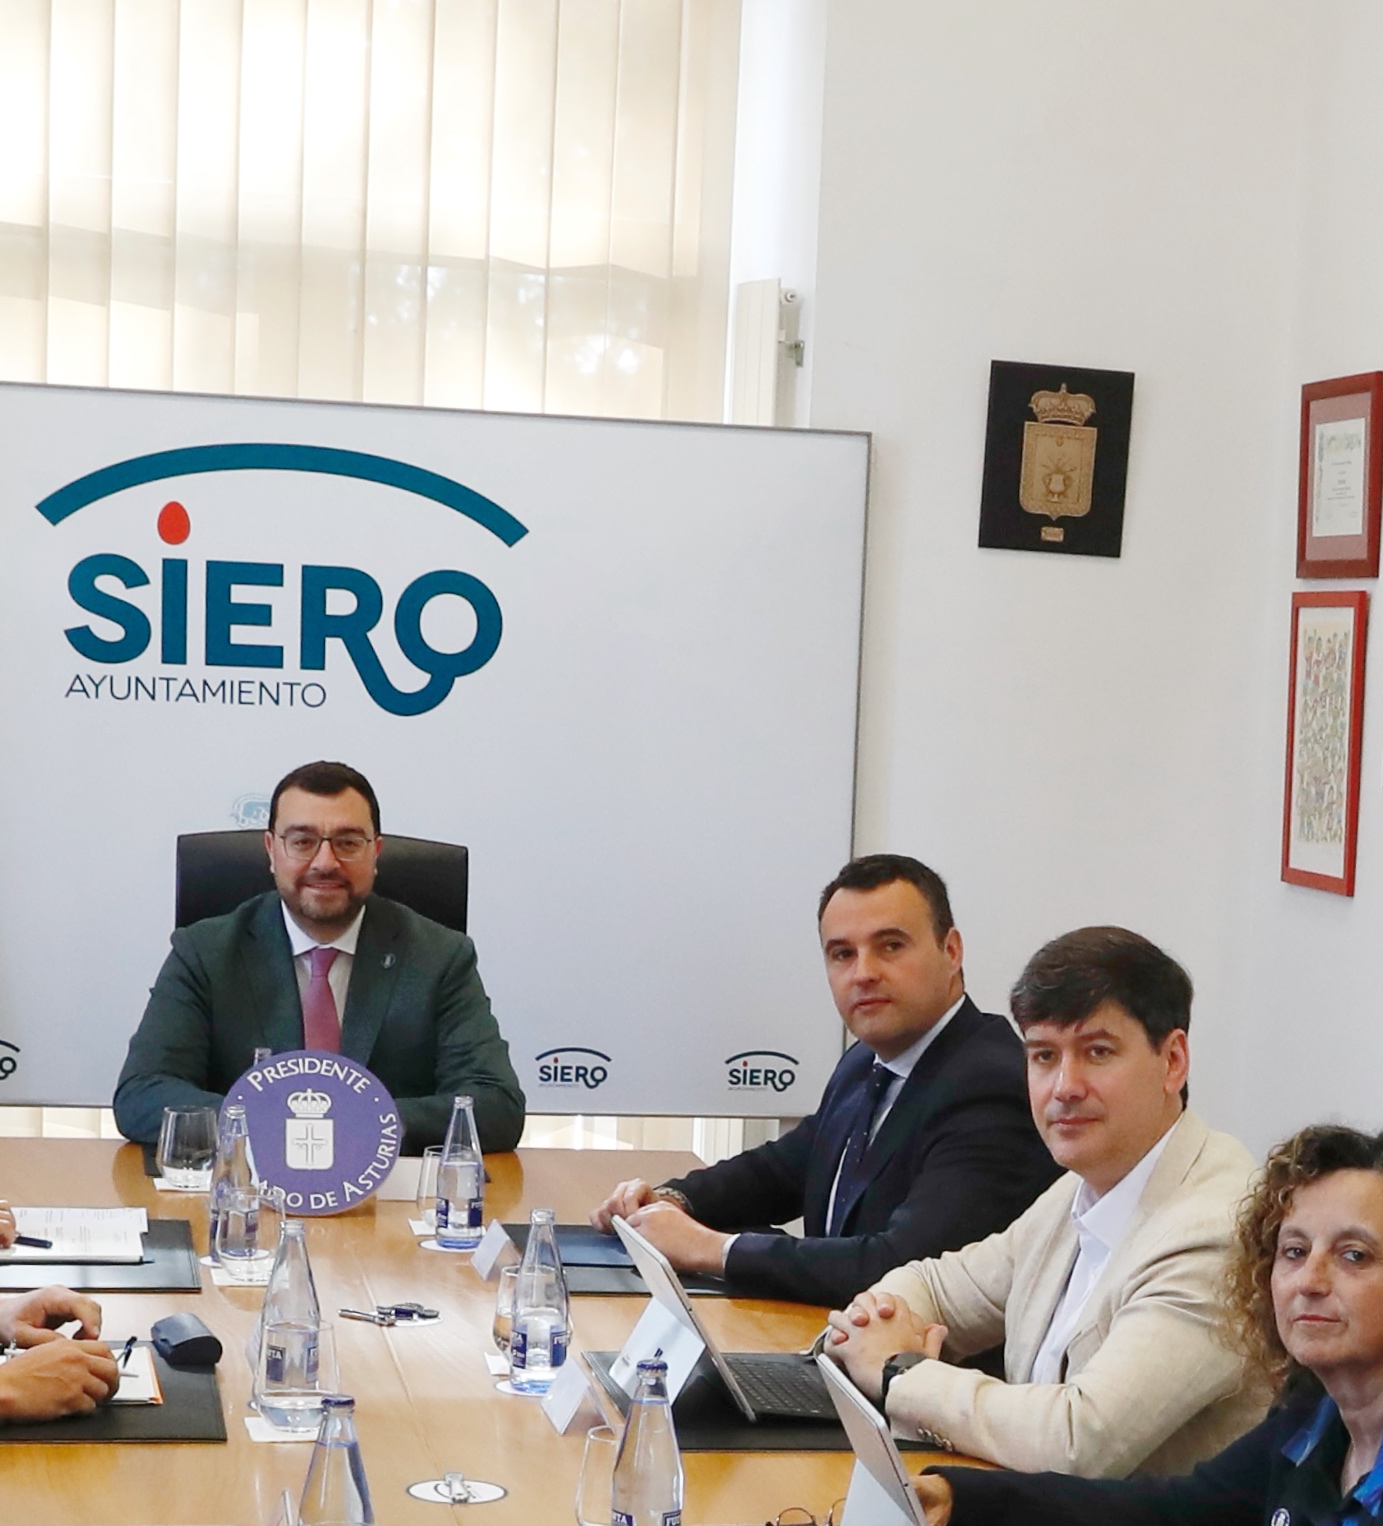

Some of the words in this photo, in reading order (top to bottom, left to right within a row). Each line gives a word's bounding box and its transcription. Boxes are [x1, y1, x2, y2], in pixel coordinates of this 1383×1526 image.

[65, 674, 327, 708] AYUNTAMIENTO
[247, 1057, 371, 1094] PRESIDENTE
[310, 1191, 338, 1209] DE
[343, 1112, 398, 1202] ASTURIAS
